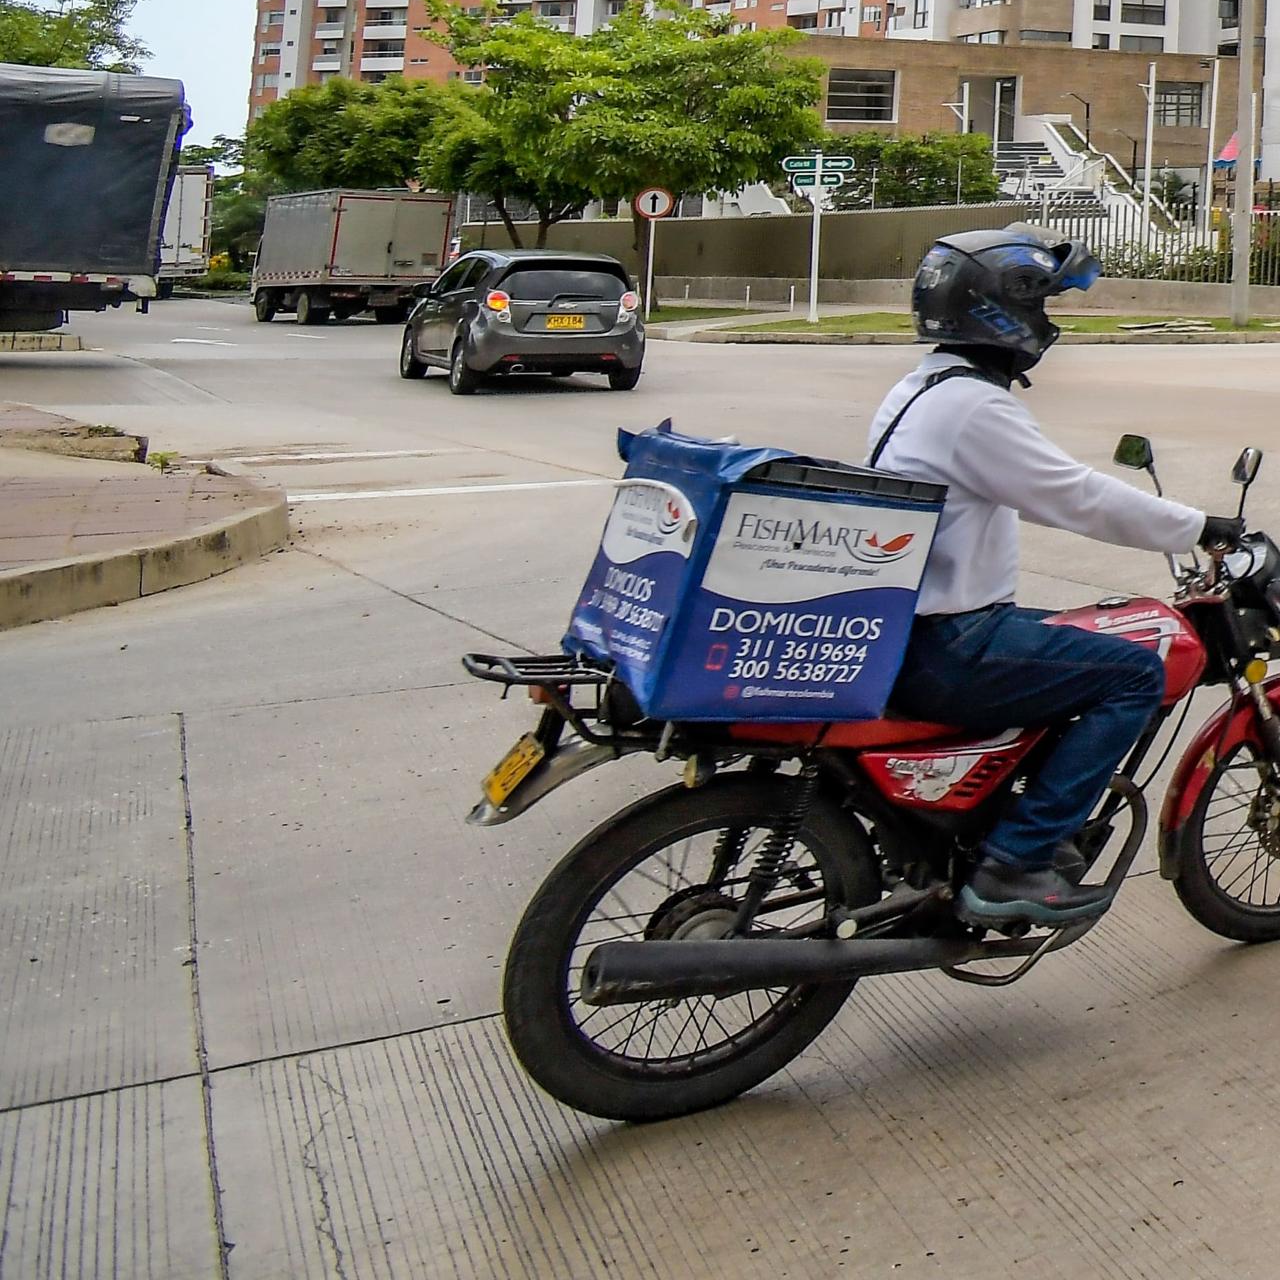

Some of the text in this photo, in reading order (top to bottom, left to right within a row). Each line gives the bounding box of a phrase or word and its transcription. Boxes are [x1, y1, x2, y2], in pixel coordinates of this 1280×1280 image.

[709, 608, 884, 640] DOMICILIOS
[736, 638, 869, 663] 311 3619694
[728, 660, 863, 683] 300 5638727
